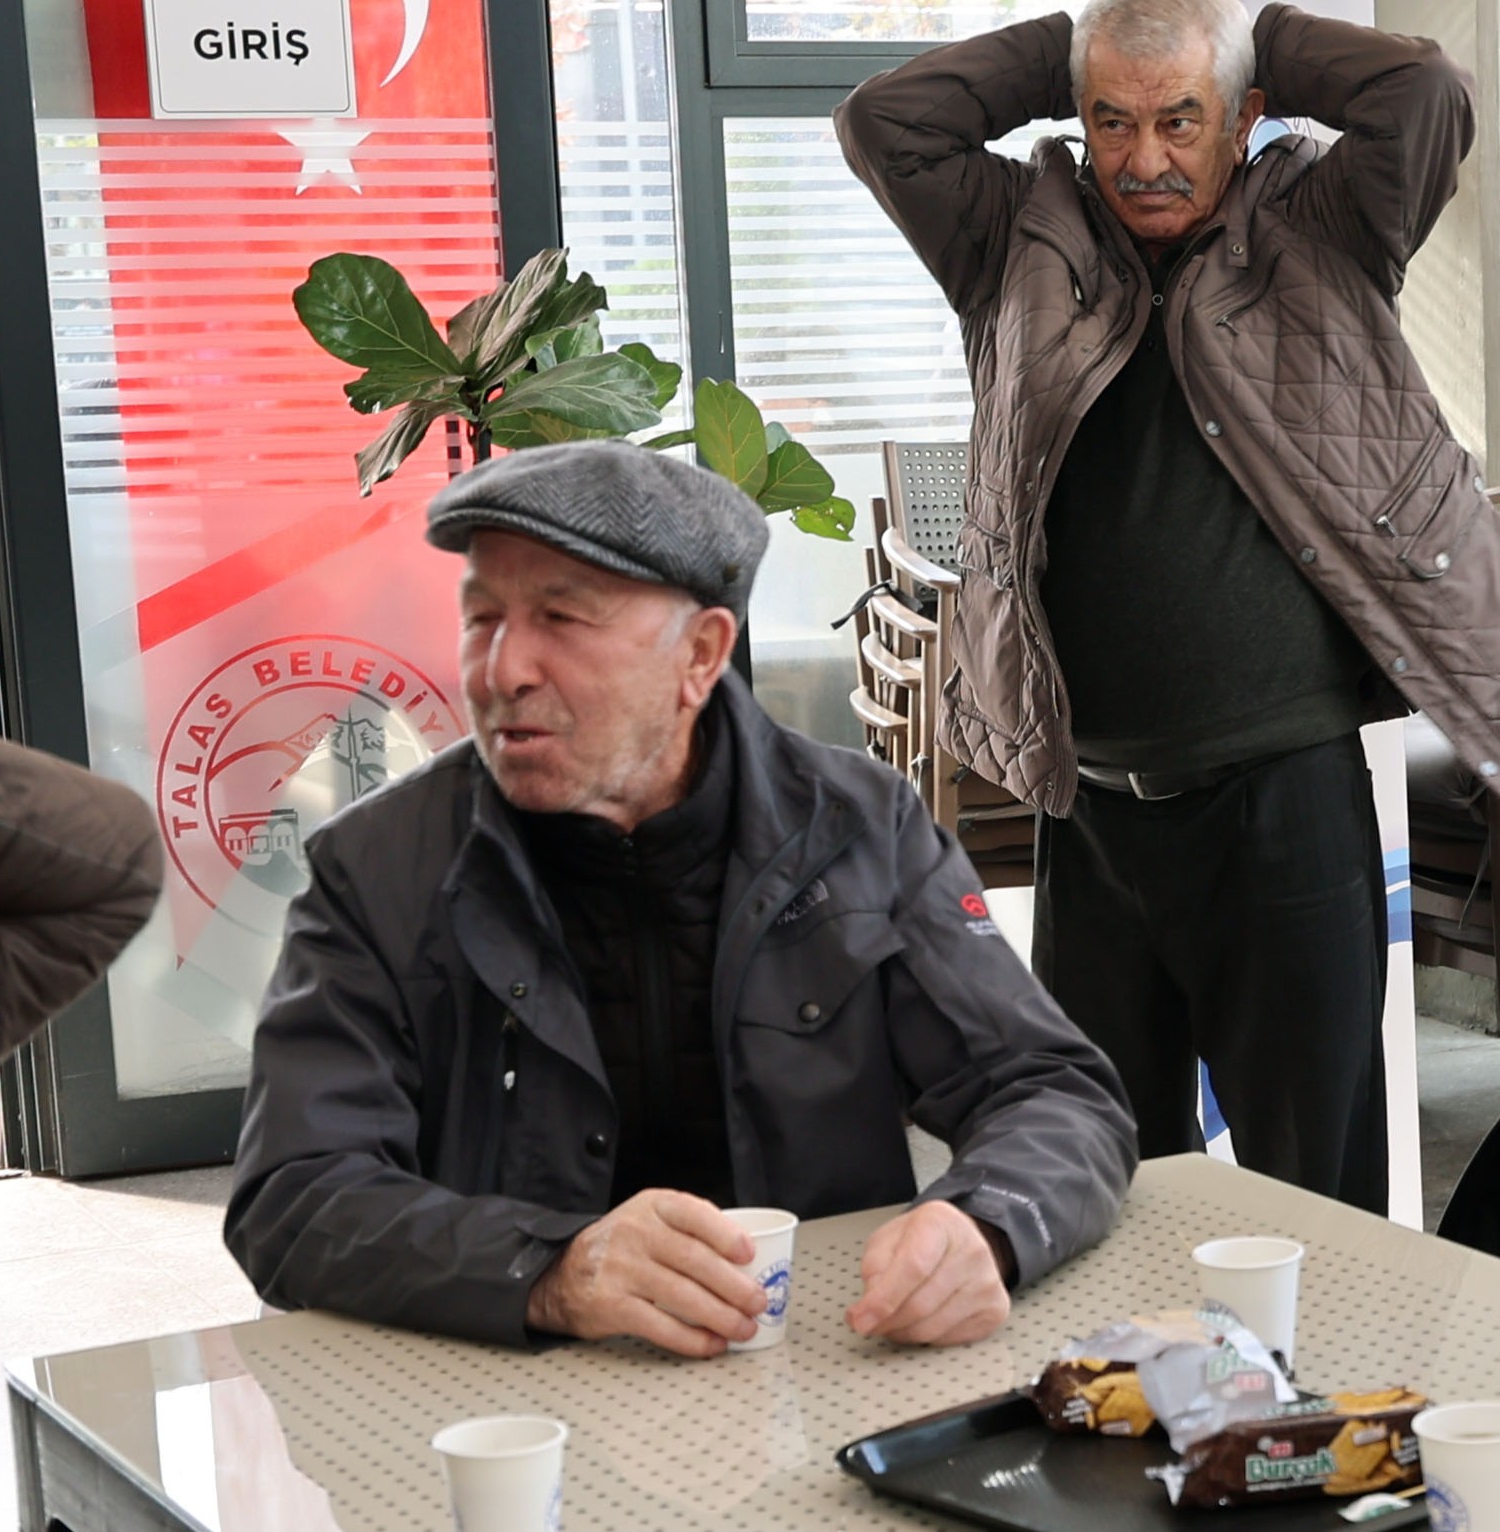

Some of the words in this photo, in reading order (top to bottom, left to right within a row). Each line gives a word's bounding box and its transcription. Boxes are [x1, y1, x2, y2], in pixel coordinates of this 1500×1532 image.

[193, 21, 309, 67] GİRİŞ
[171, 692, 233, 838] TALAS
[252, 650, 445, 734] BELEDİY
